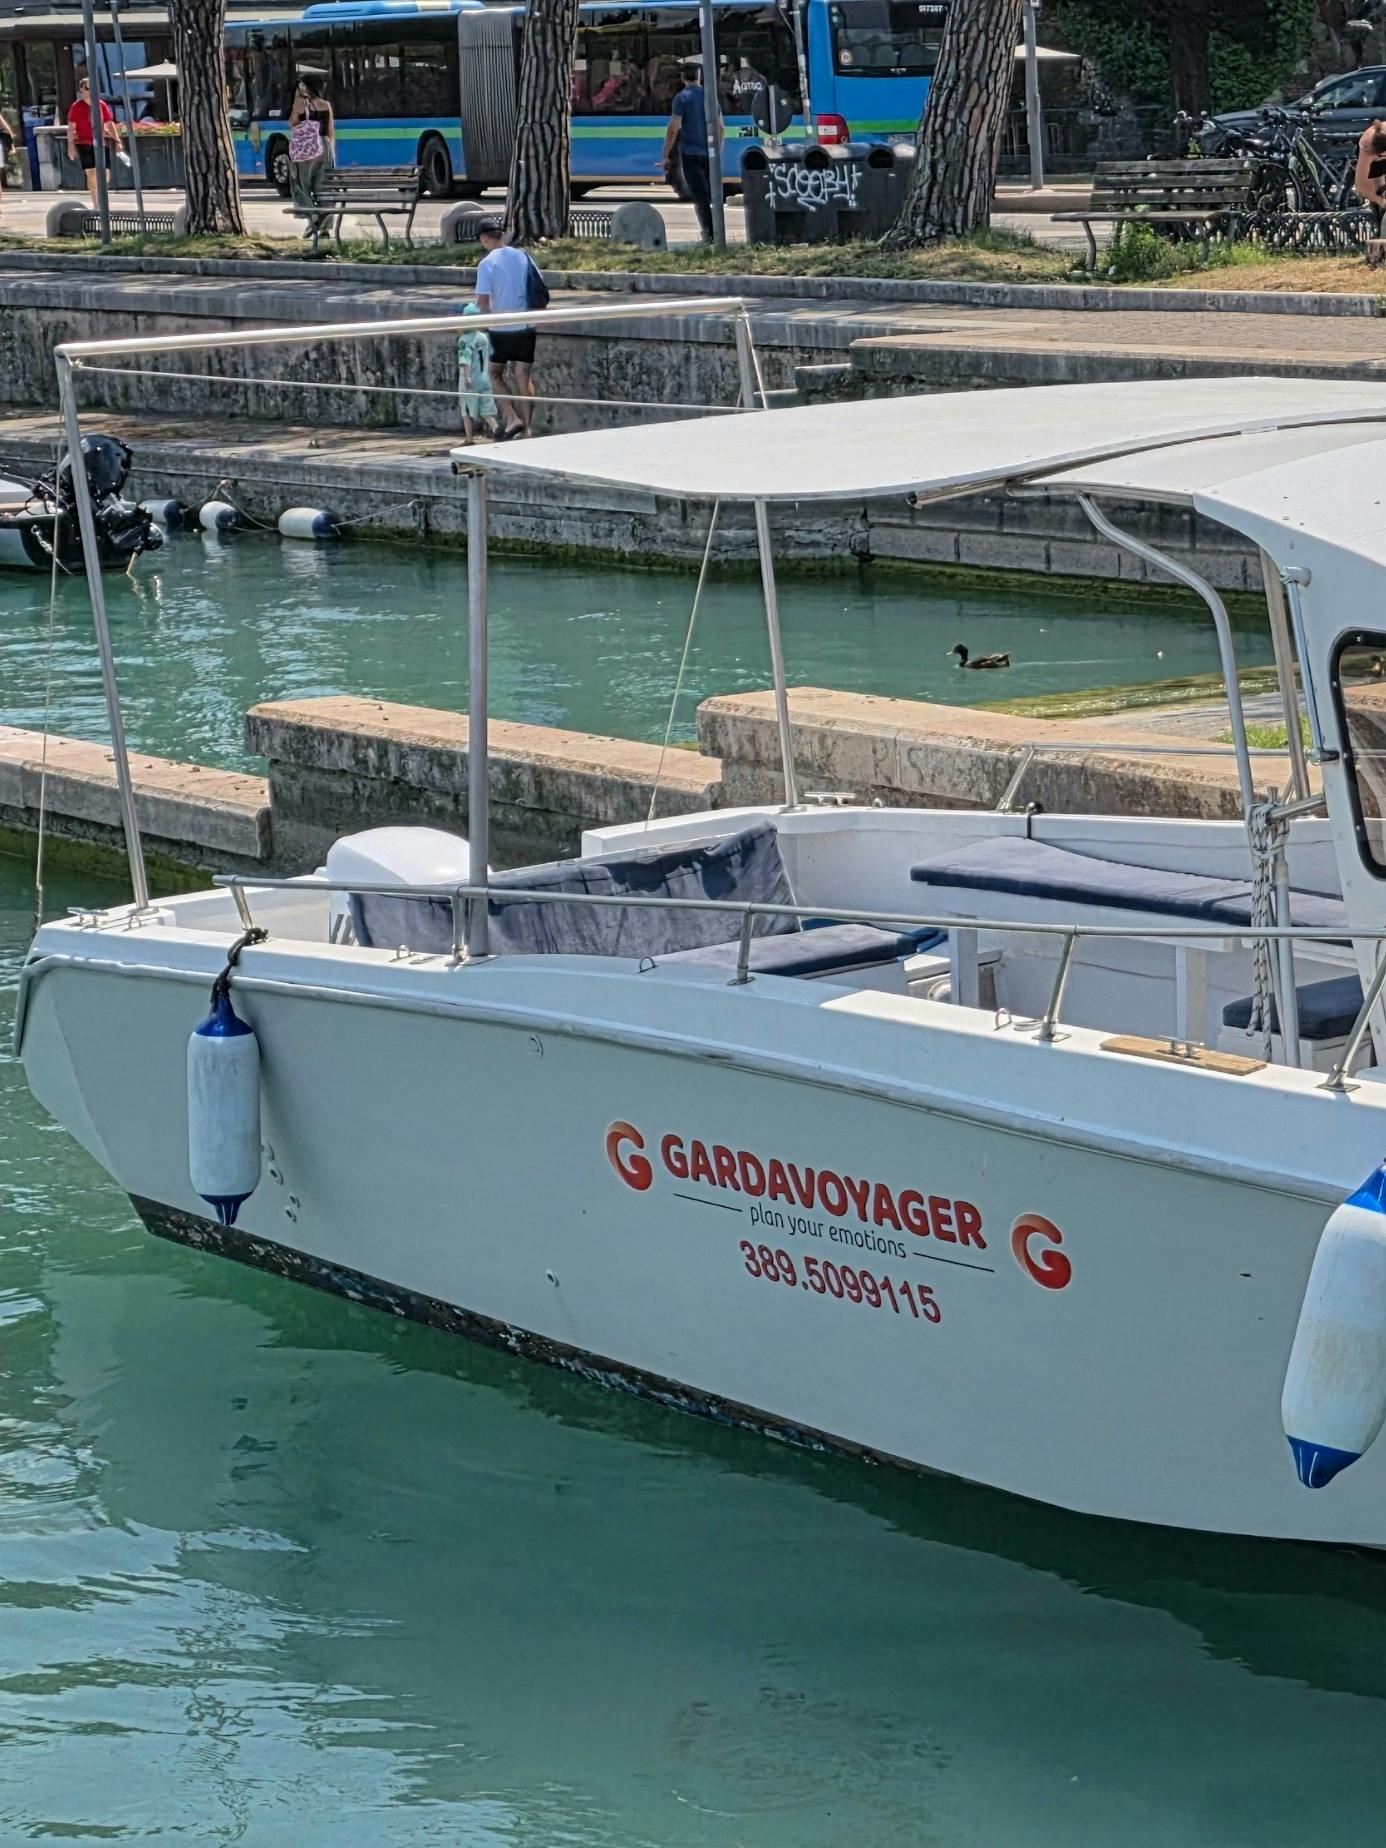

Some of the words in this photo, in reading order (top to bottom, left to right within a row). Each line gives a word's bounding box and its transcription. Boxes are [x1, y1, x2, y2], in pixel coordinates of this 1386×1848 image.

[660, 1133, 987, 1249] GARDAVOYAGER
[750, 1202, 784, 1226] plan
[787, 1215, 824, 1237] your
[829, 1226, 907, 1258] emotions
[739, 1240, 942, 1324] 389.5099115
